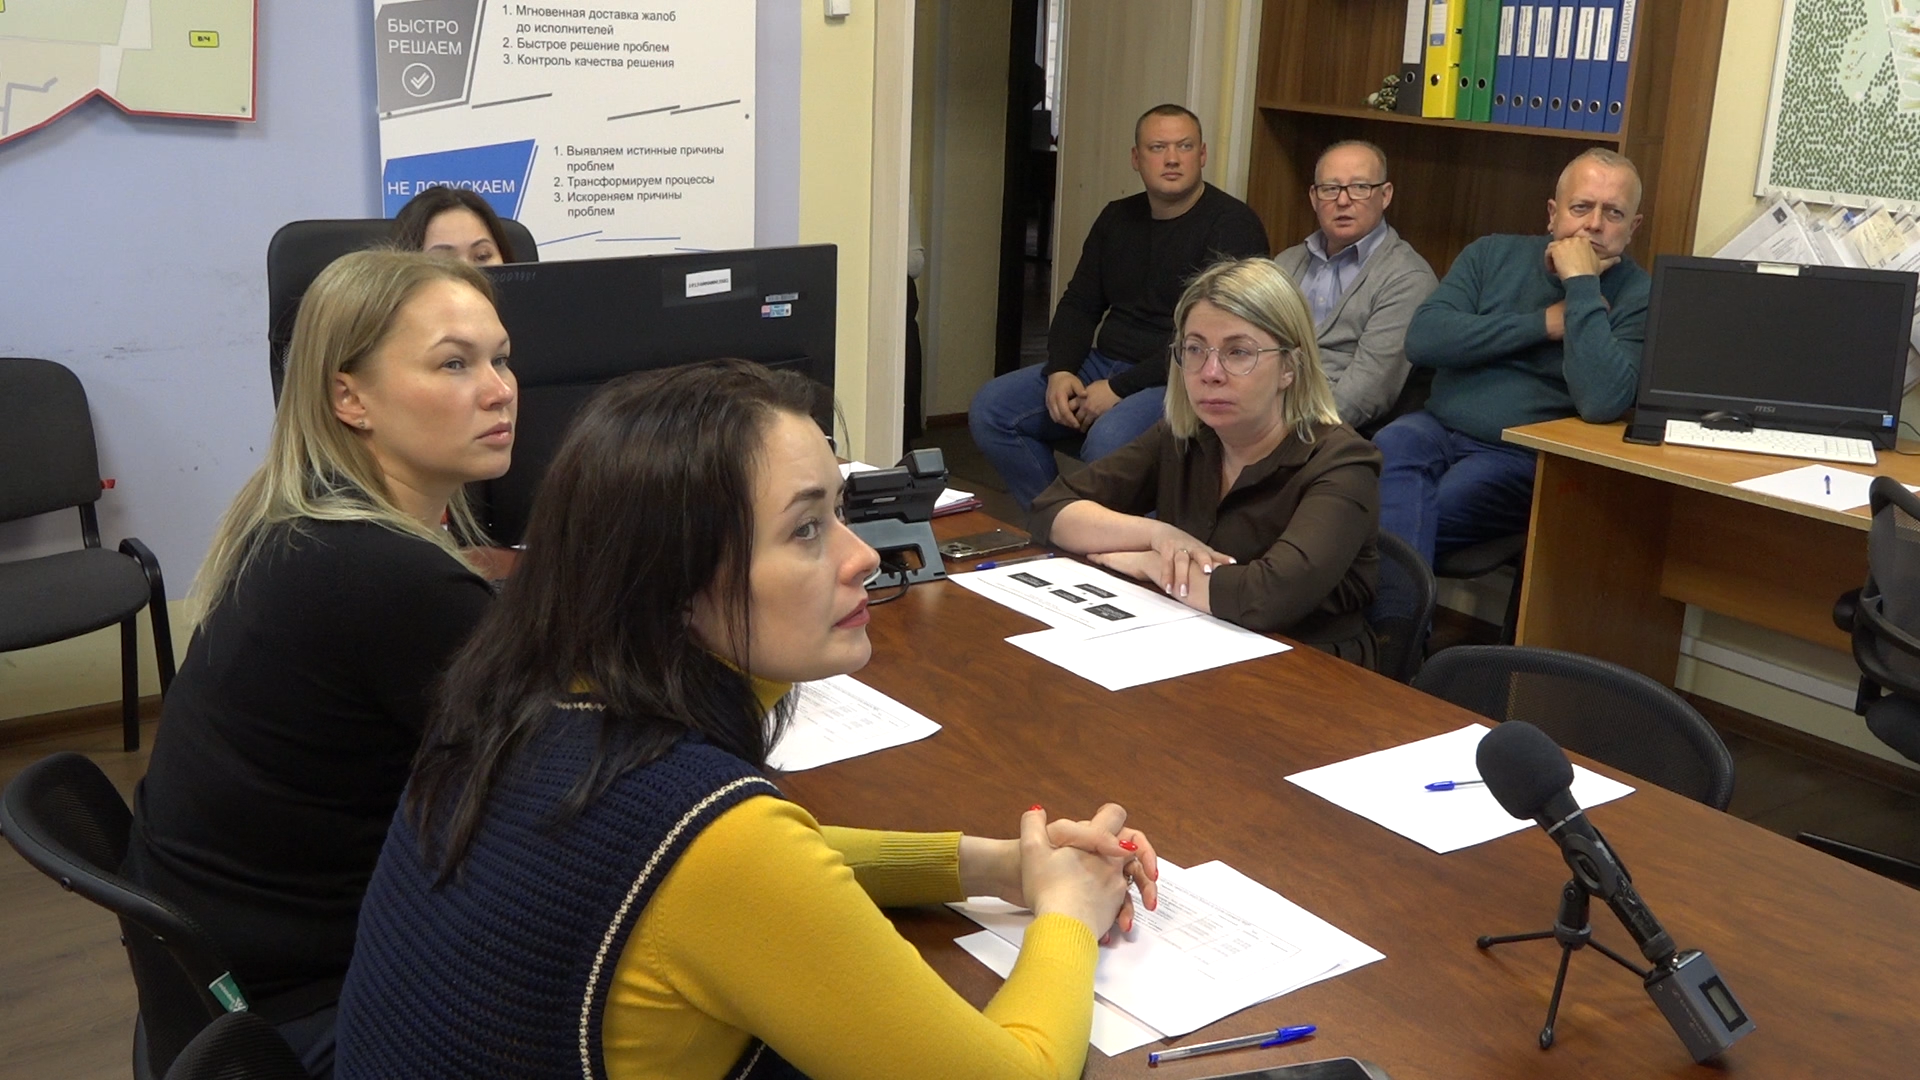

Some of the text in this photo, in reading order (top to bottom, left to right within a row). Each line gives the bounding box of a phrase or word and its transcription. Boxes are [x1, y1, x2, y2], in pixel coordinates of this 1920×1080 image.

[502, 5, 676, 22] 1. Мгновенная доставка жалоб
[387, 18, 459, 35] БЫСТРО
[516, 23, 614, 36] до исполнителей
[388, 40, 462, 56] РЕШАЕМ
[502, 37, 670, 53] 2. Быстрое решение проблем
[503, 54, 675, 71] 3. Контроль качества решения
[554, 145, 725, 157] 1. Выявляем истинные причины
[566, 161, 615, 173] проблем
[387, 181, 410, 195] НЕ
[553, 175, 715, 188] 2. Трансформируем процессы
[553, 191, 682, 204] 3. Искореняем причины
[567, 206, 615, 218] проблем
